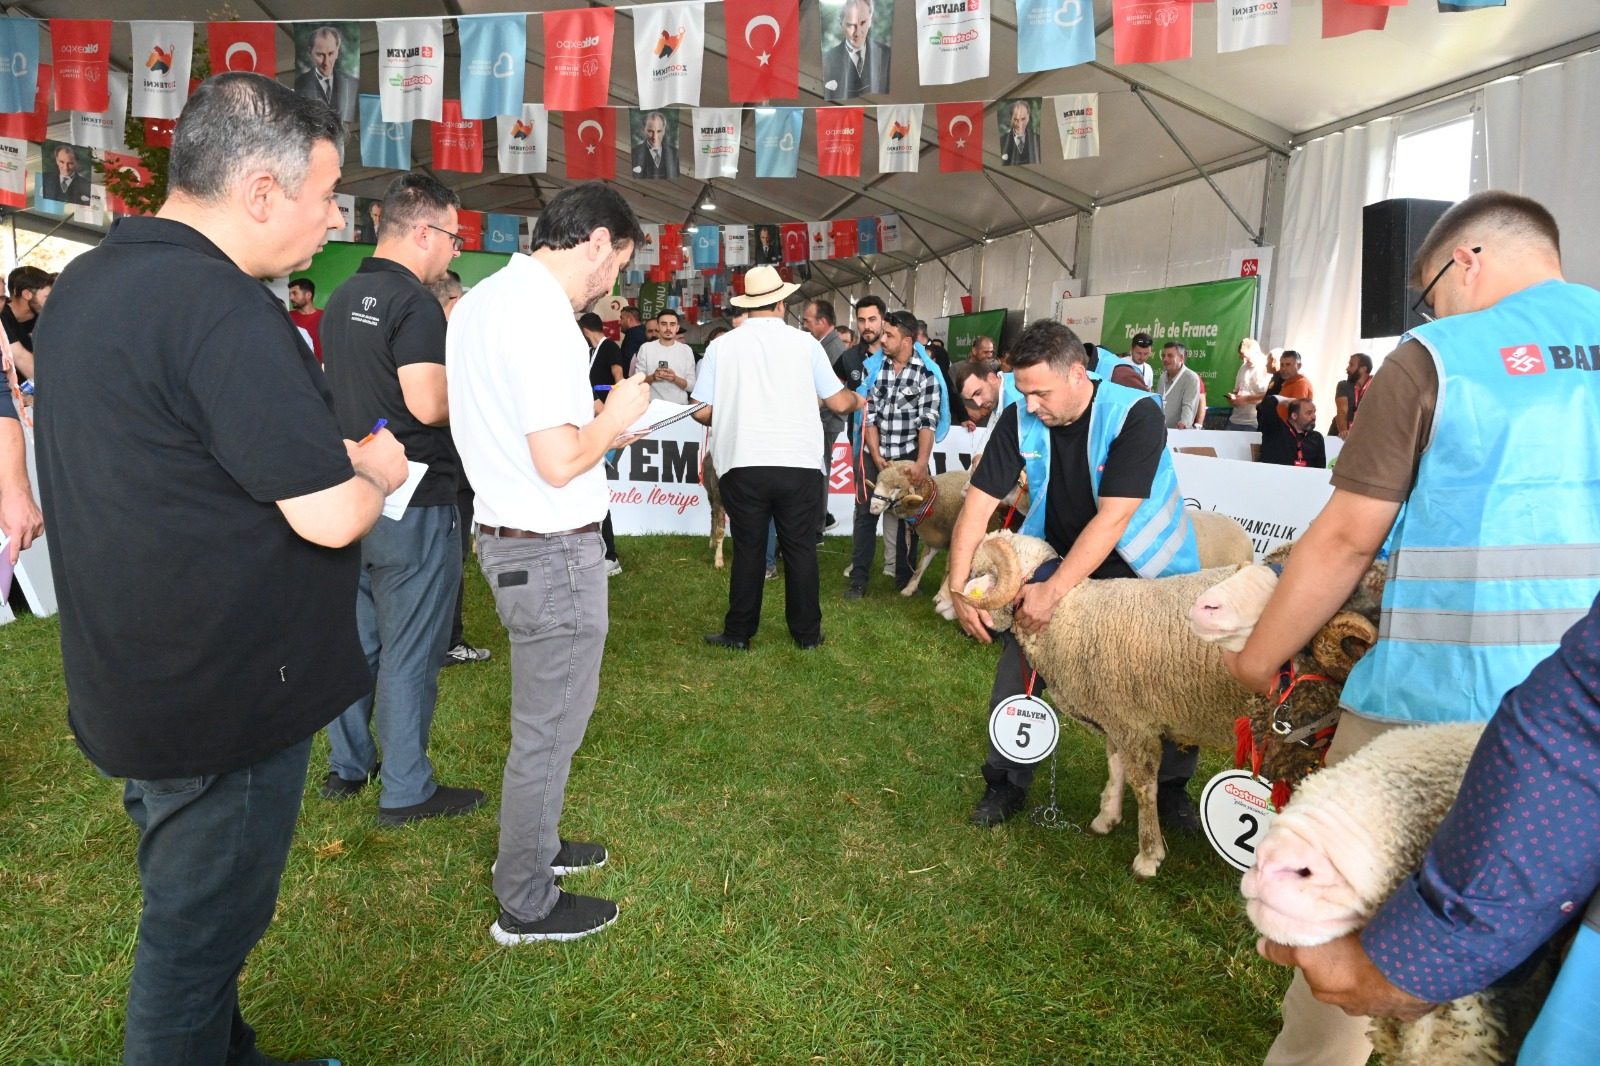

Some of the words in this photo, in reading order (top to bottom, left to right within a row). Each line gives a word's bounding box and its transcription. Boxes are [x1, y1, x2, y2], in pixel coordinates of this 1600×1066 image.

[655, 285, 666, 317] YUNU
[1168, 321, 1180, 338] de
[1182, 321, 1218, 338] France
[609, 487, 643, 505] mle
[1017, 709, 1046, 720] BALYEM
[1016, 722, 1031, 748] 5
[1225, 784, 1267, 809] dostum
[1234, 813, 1259, 855] 2
